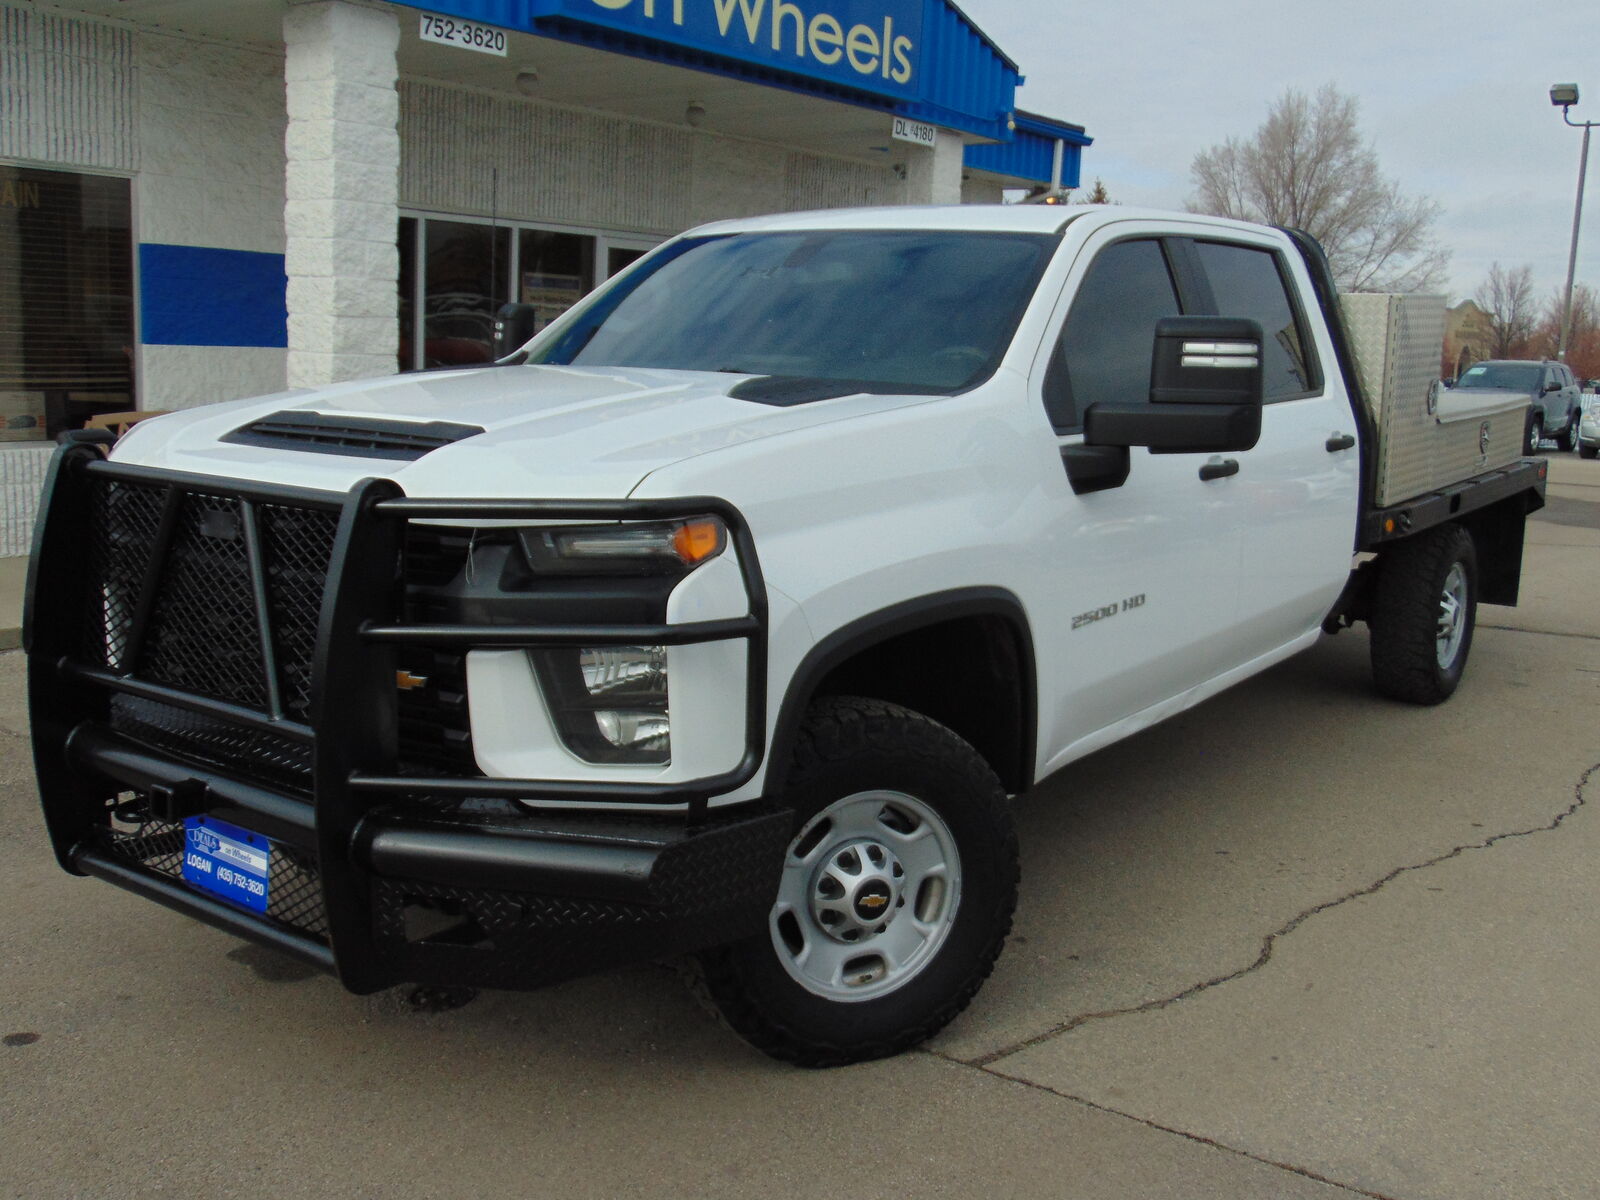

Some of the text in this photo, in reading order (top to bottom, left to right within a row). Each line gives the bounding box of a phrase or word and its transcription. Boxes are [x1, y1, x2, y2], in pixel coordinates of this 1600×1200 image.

[422, 15, 505, 51] 752-3620
[713, 0, 912, 83] Wheels
[895, 120, 908, 136] DL
[1071, 593, 1145, 630] 2500 HD
[193, 830, 217, 848] DEALS
[187, 853, 264, 896] LOGAN (435) 752-3620
